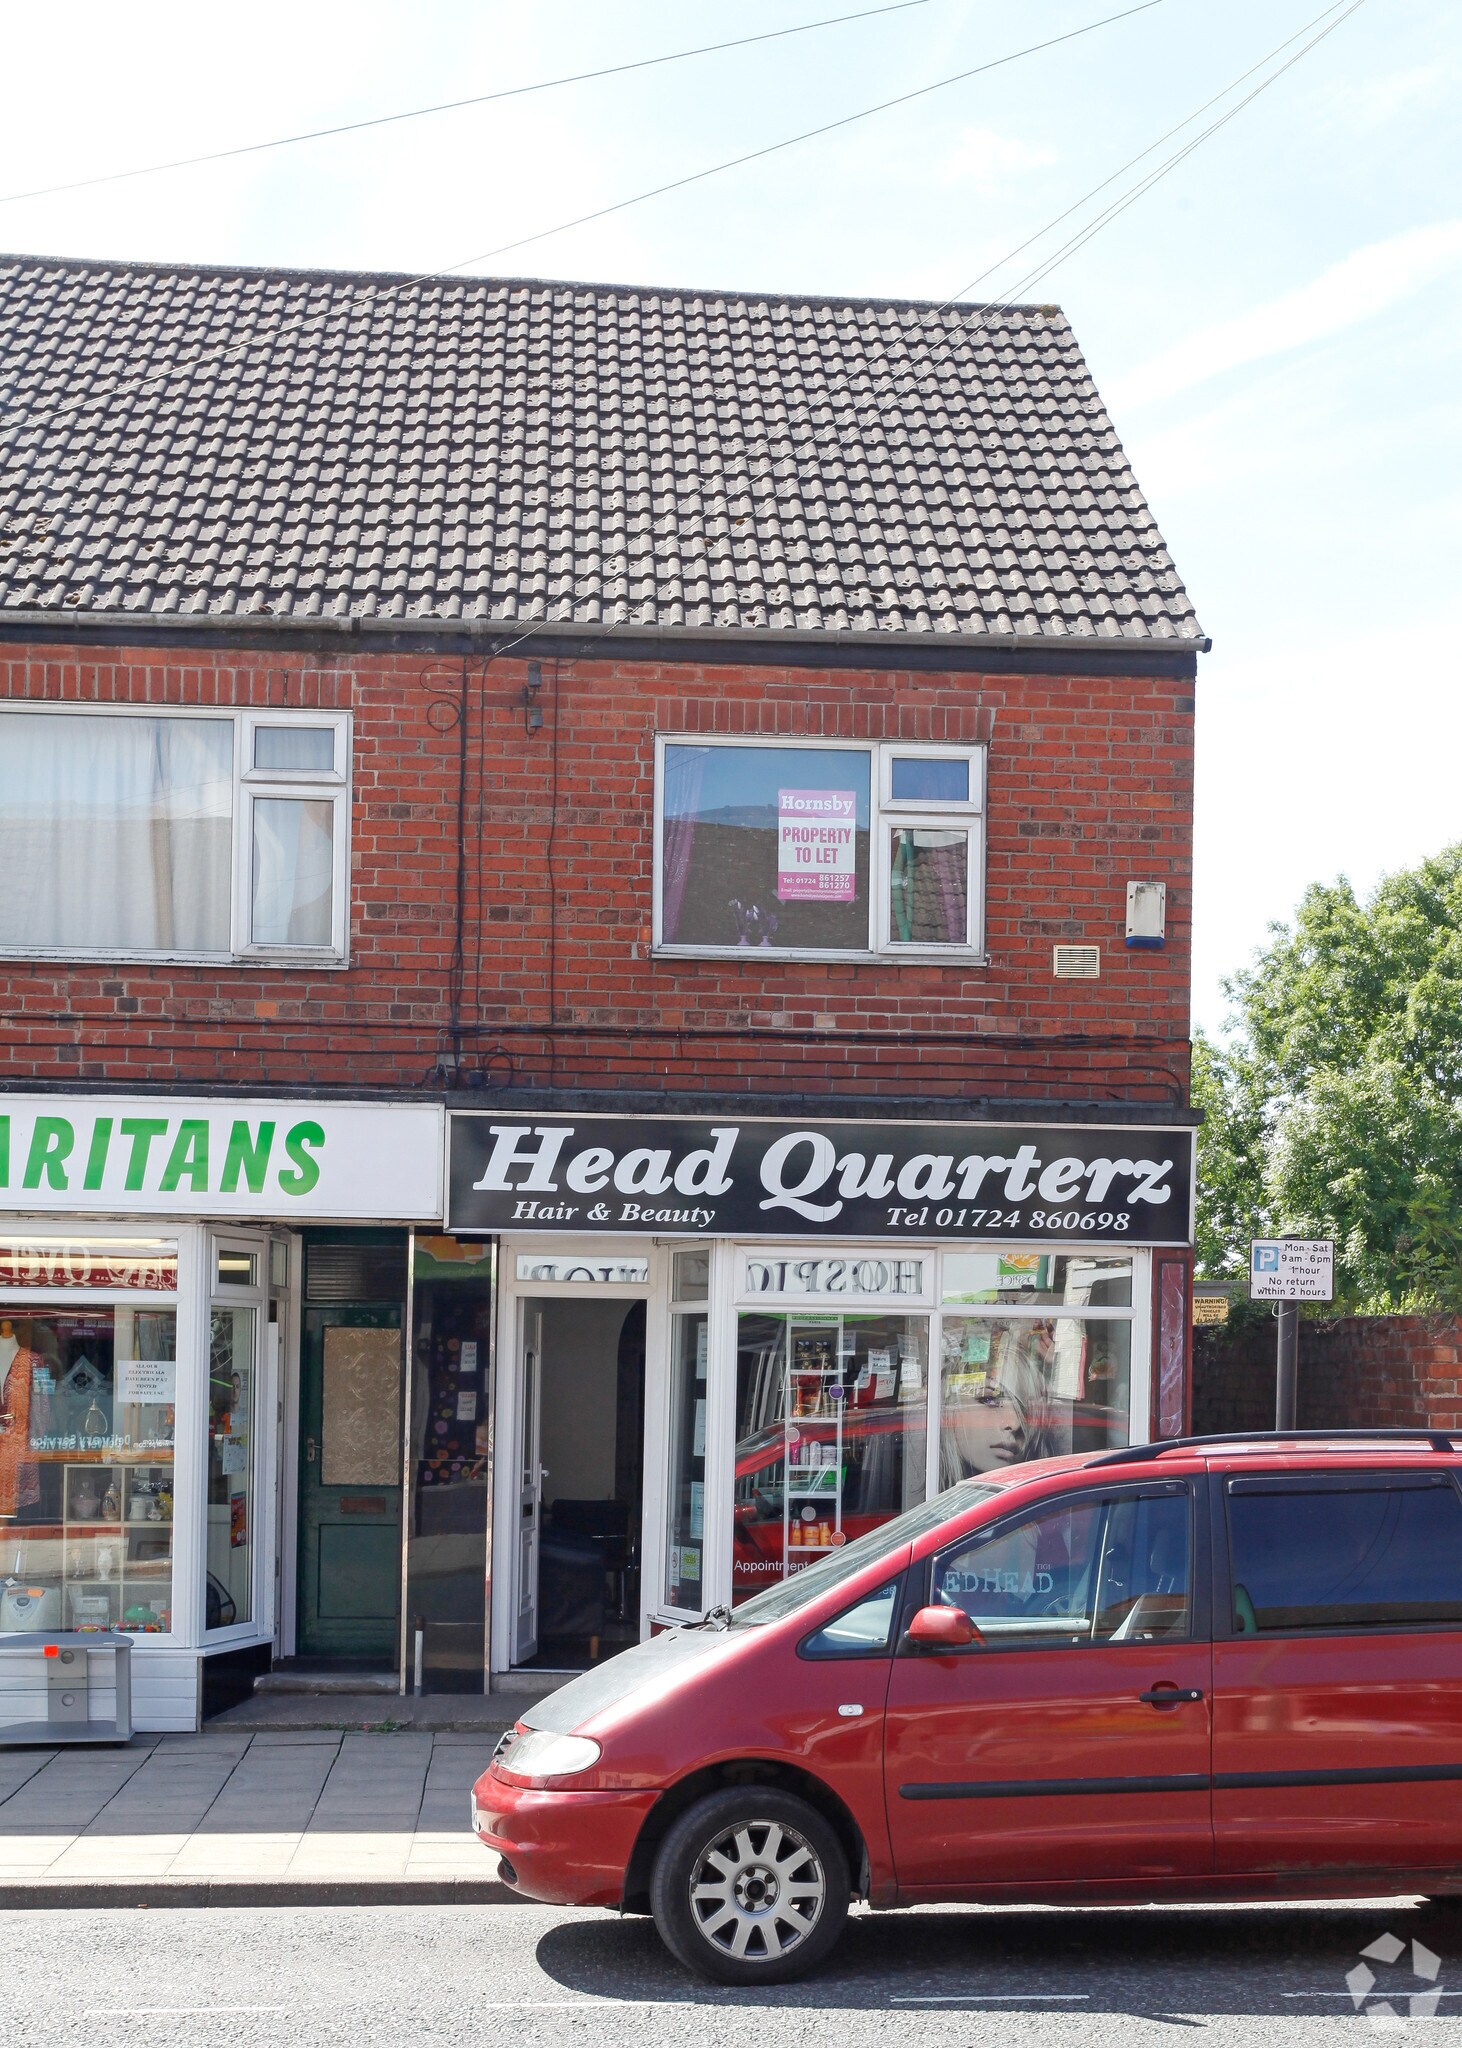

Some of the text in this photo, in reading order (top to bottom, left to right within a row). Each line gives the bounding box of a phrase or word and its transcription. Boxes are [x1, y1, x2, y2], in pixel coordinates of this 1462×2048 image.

[781, 795, 854, 815] Hornsby
[782, 826, 852, 844] PROPERTY
[795, 846, 839, 864] TO LET
[819, 874, 850, 882] 861257
[819, 881, 850, 889] 861270
[472, 1125, 1174, 1223] Head Quarterz
[511, 1200, 716, 1228] Hair & Beauty
[885, 1206, 1131, 1231] Tel 01724 860698
[1284, 1243, 1305, 1252] Mon
[1312, 1243, 1329, 1253] Sat
[1299, 1266, 1321, 1274] hour
[1268, 1277, 1315, 1286] No return
[1257, 1287, 1326, 1296] within 2 hours
